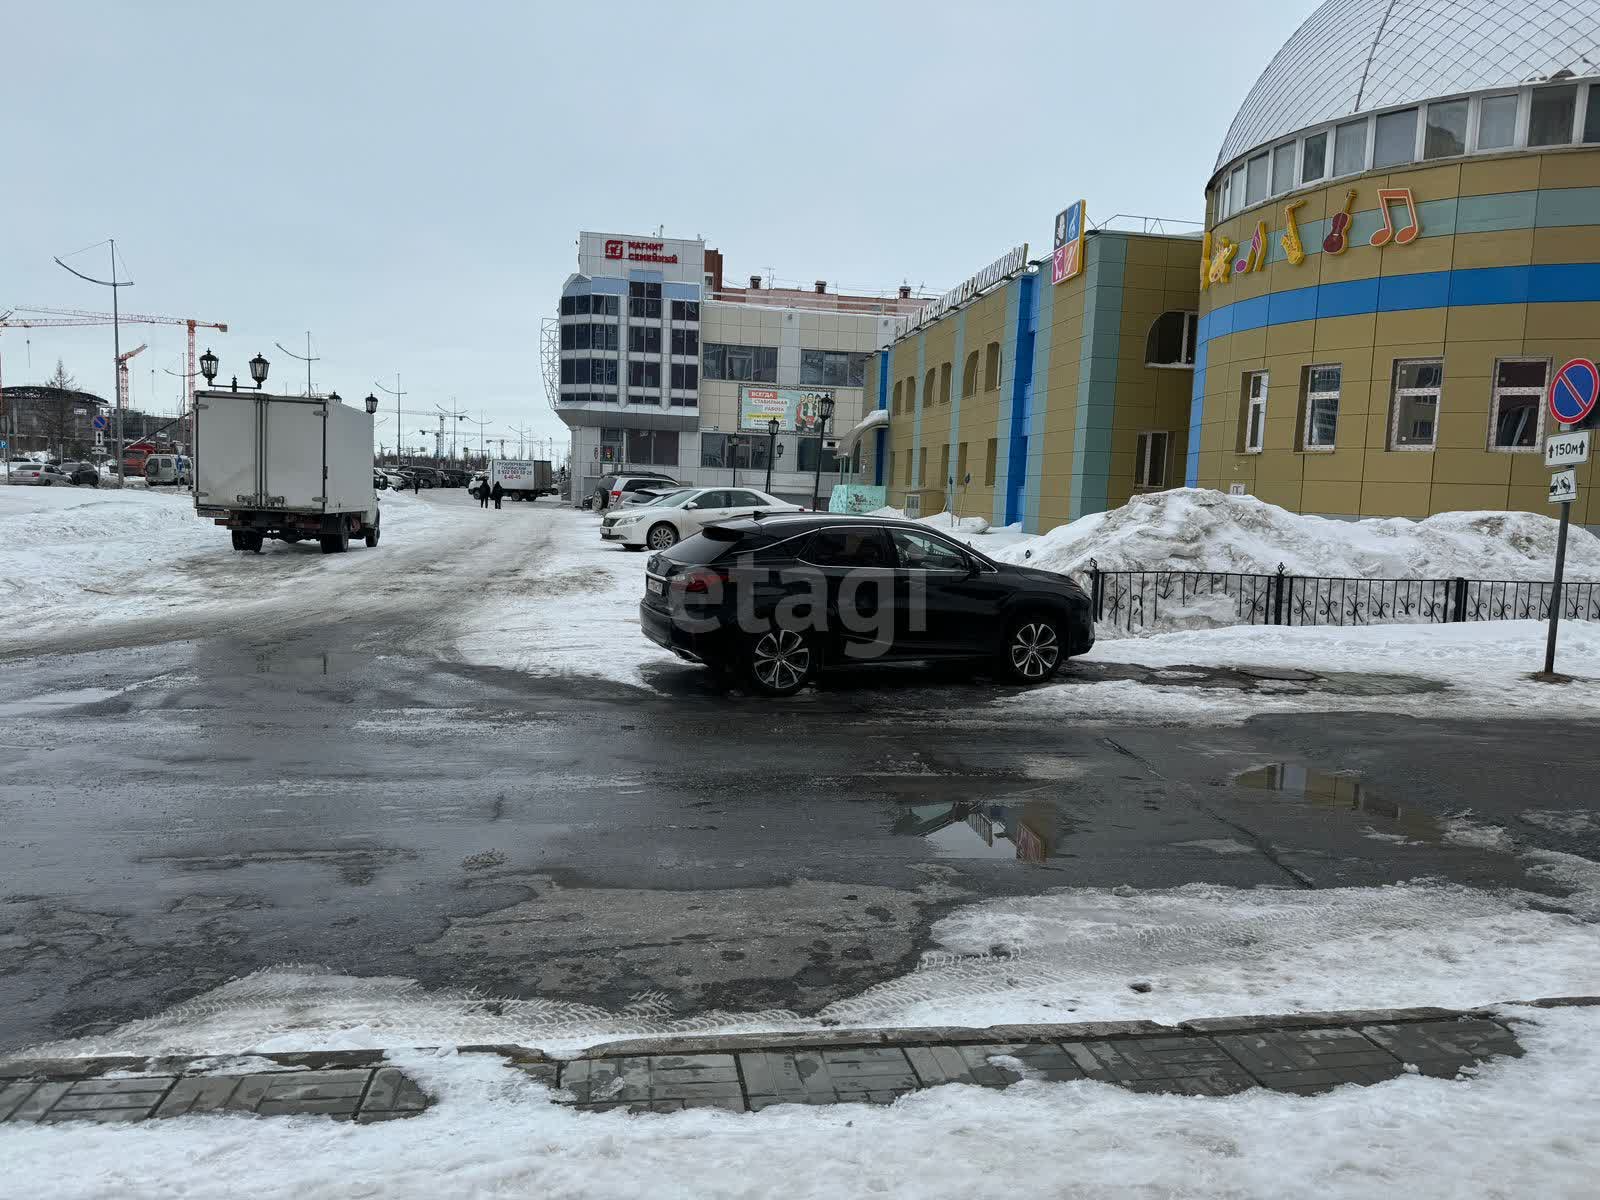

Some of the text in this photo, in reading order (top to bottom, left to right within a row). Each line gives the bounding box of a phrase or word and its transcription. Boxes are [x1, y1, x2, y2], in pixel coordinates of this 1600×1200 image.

[628, 241, 664, 251] МАГНИТ
[628, 253, 678, 264] СЕМЕЙНЫЙ
[751, 391, 774, 399] ВСЕГДА
